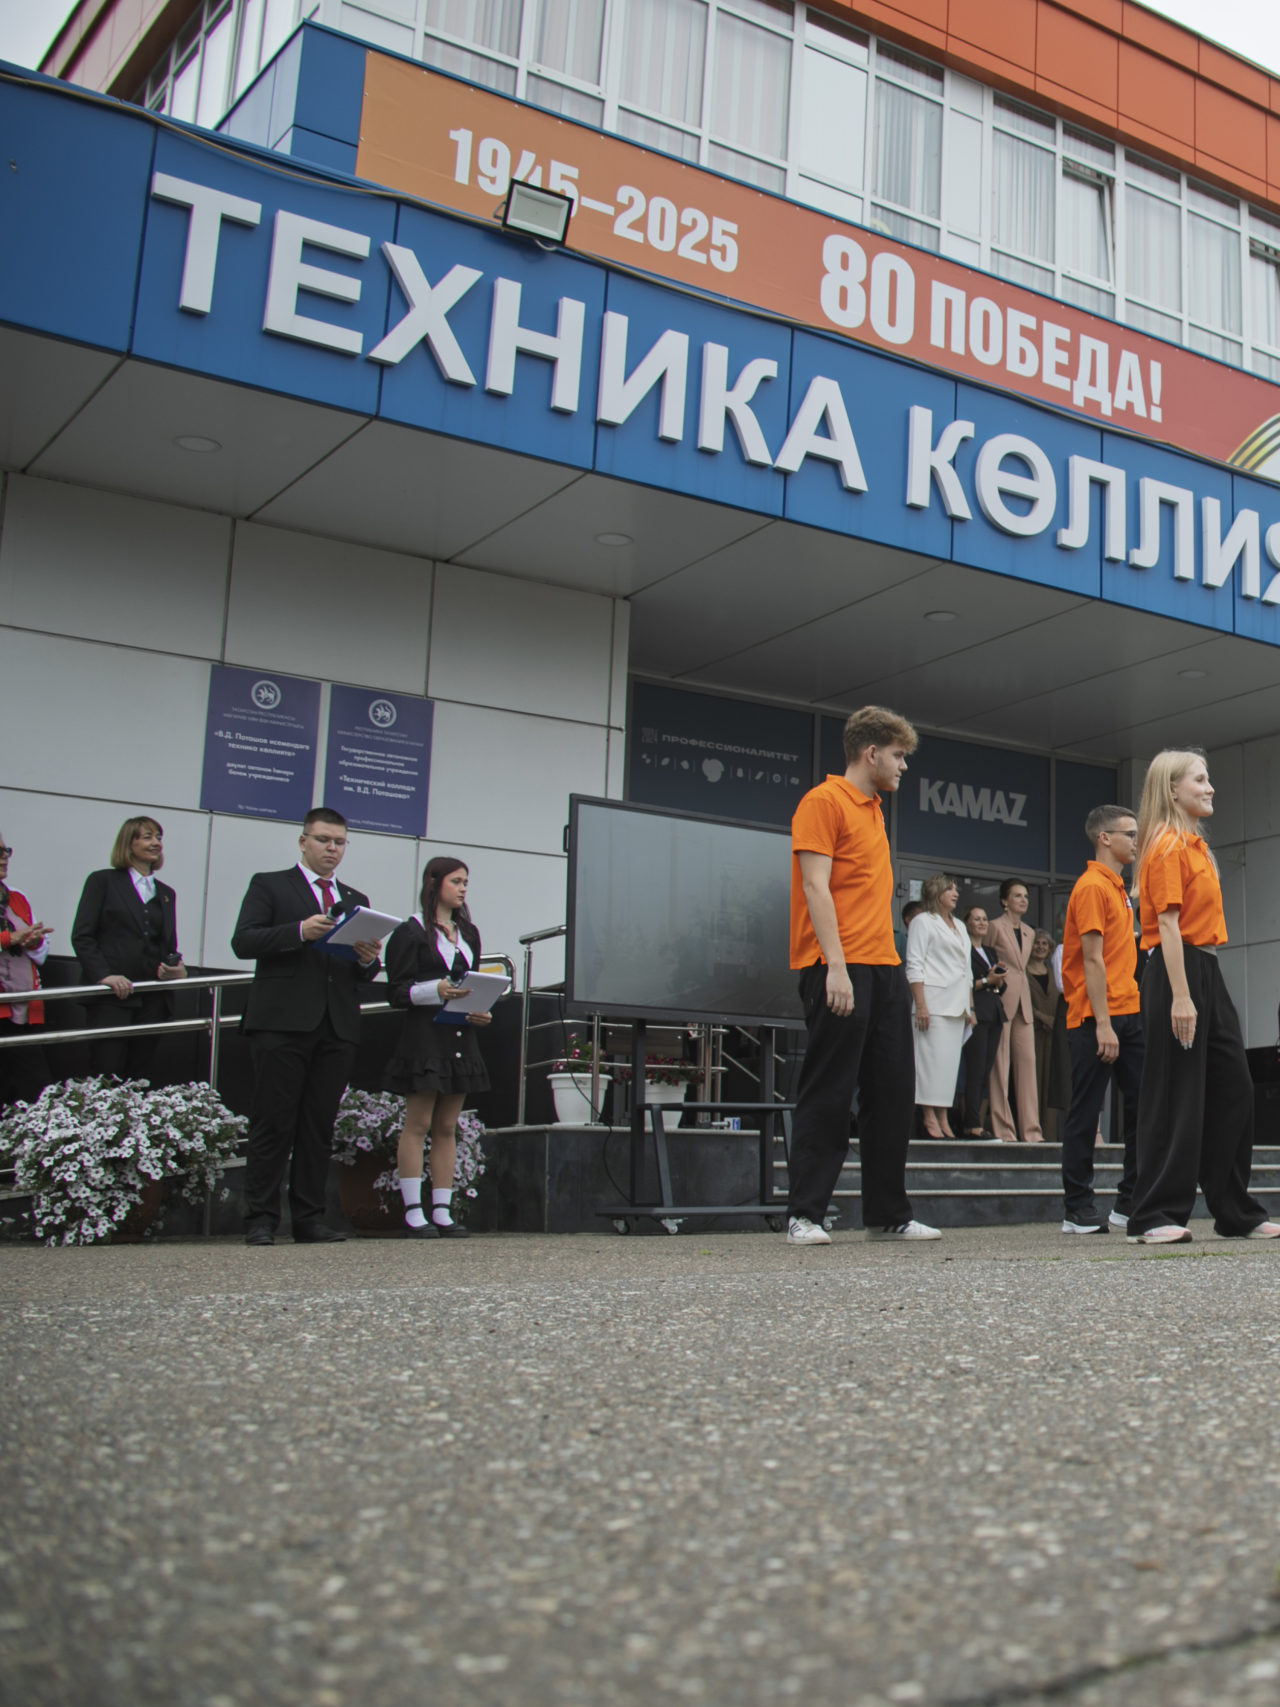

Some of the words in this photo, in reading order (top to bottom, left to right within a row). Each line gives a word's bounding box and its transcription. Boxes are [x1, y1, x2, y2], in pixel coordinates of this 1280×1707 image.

[151, 171, 868, 493] ТЕХНИКА
[820, 233, 916, 345] 80
[930, 279, 1163, 423] ПОБЕДА!
[661, 733, 799, 763] ПРОФЕССИОНАЛИТЕТ
[919, 776, 1028, 828] KAMAZ
